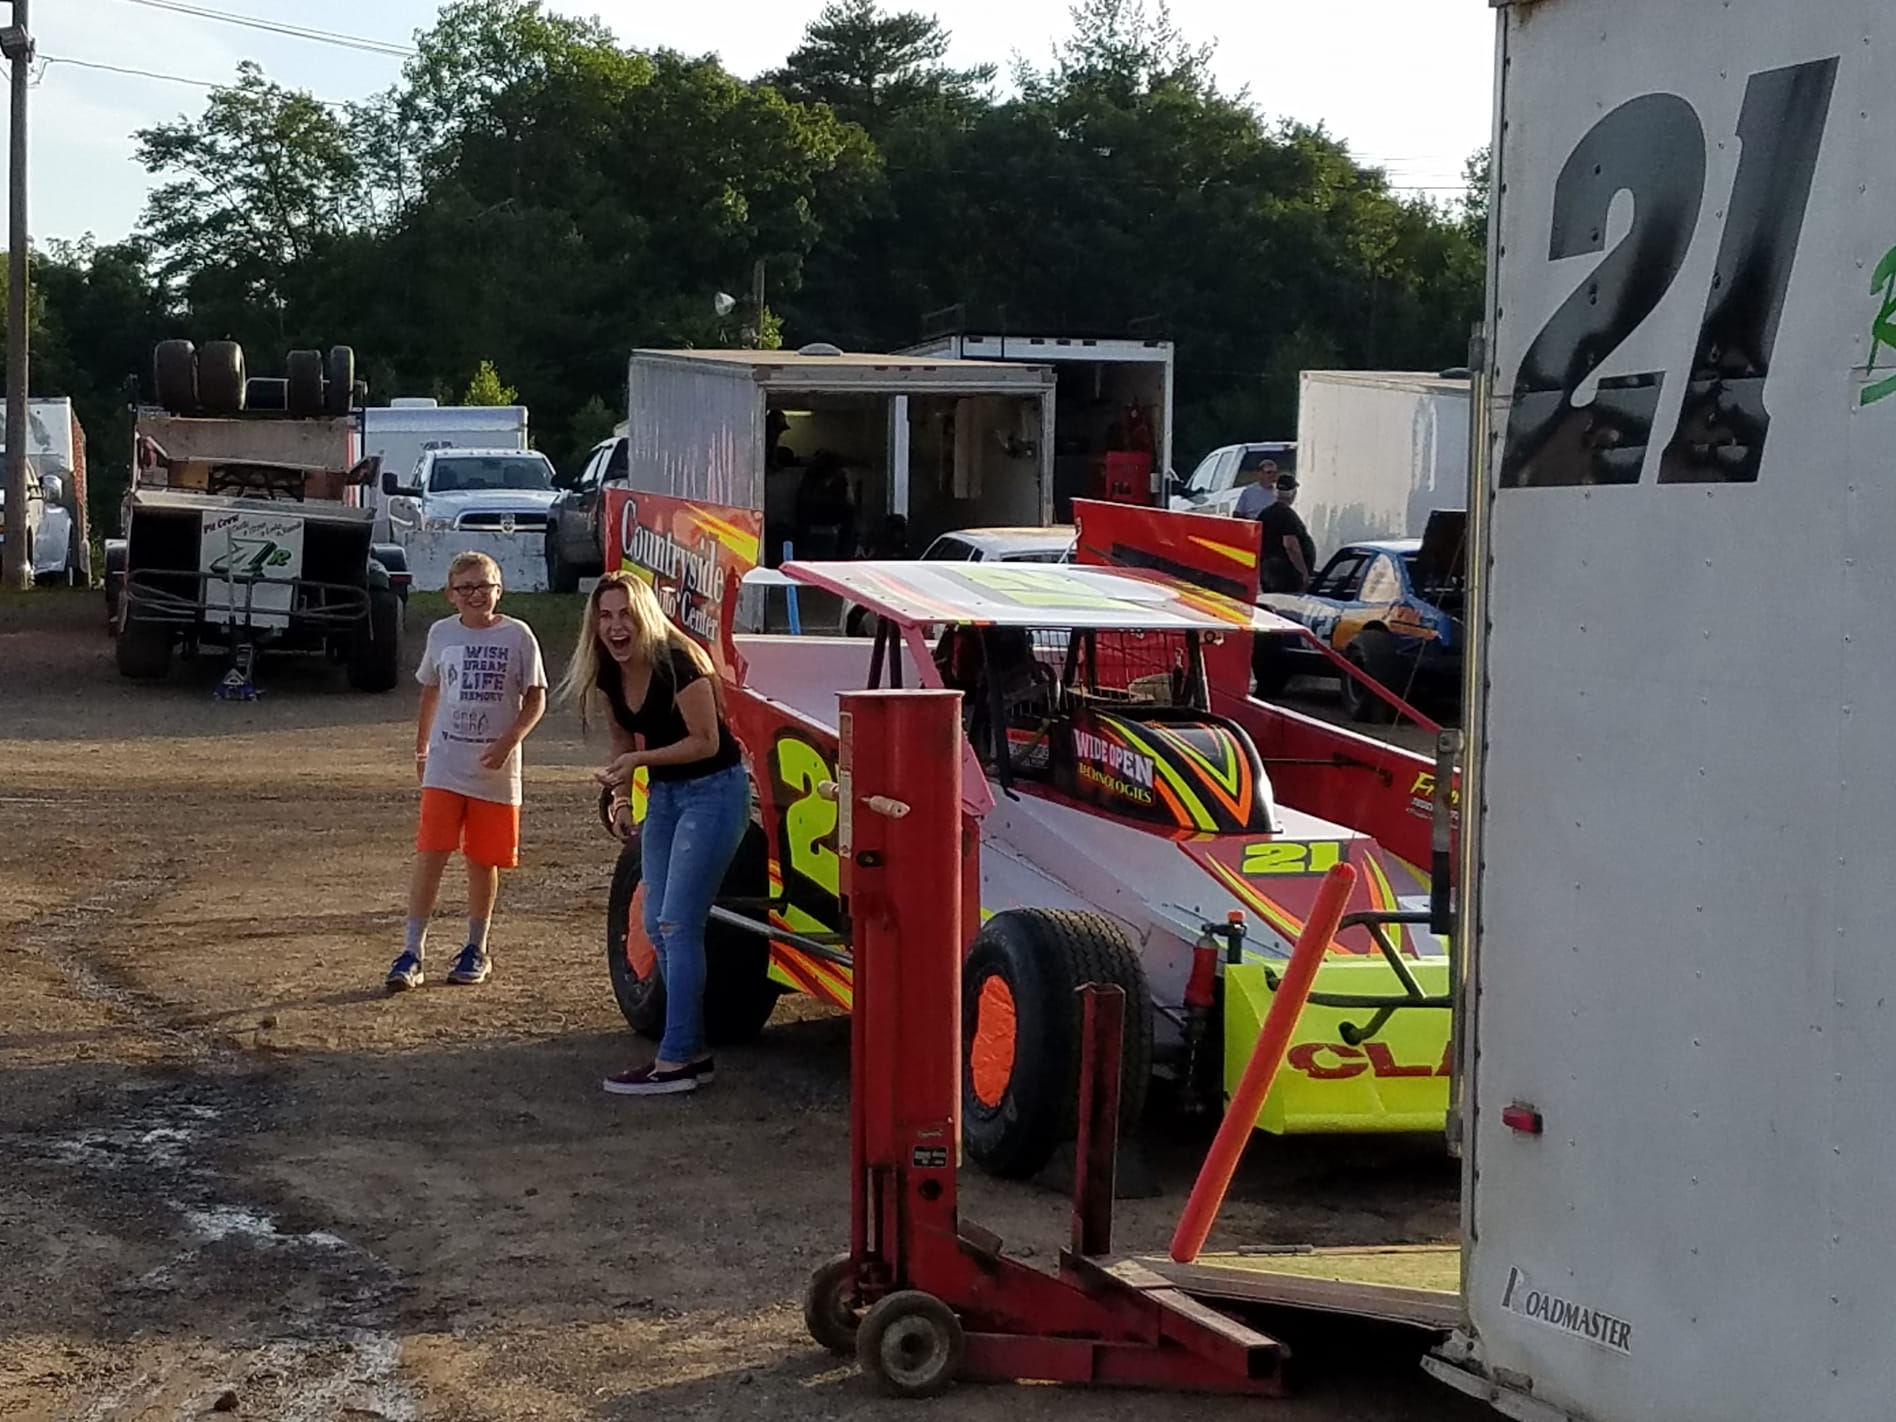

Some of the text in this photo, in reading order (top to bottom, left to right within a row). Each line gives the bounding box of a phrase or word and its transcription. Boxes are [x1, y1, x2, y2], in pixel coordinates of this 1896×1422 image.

[1500, 56, 1841, 489] 21
[621, 499, 725, 603] Countryside
[680, 591, 719, 642] Center
[465, 645, 509, 661] WISH
[461, 672, 506, 691] LIFE
[1073, 727, 1109, 763] WIDE
[1108, 743, 1154, 788] OPEN
[1079, 761, 1152, 804] TECHNOLOGIES
[1243, 842, 1340, 874] 21
